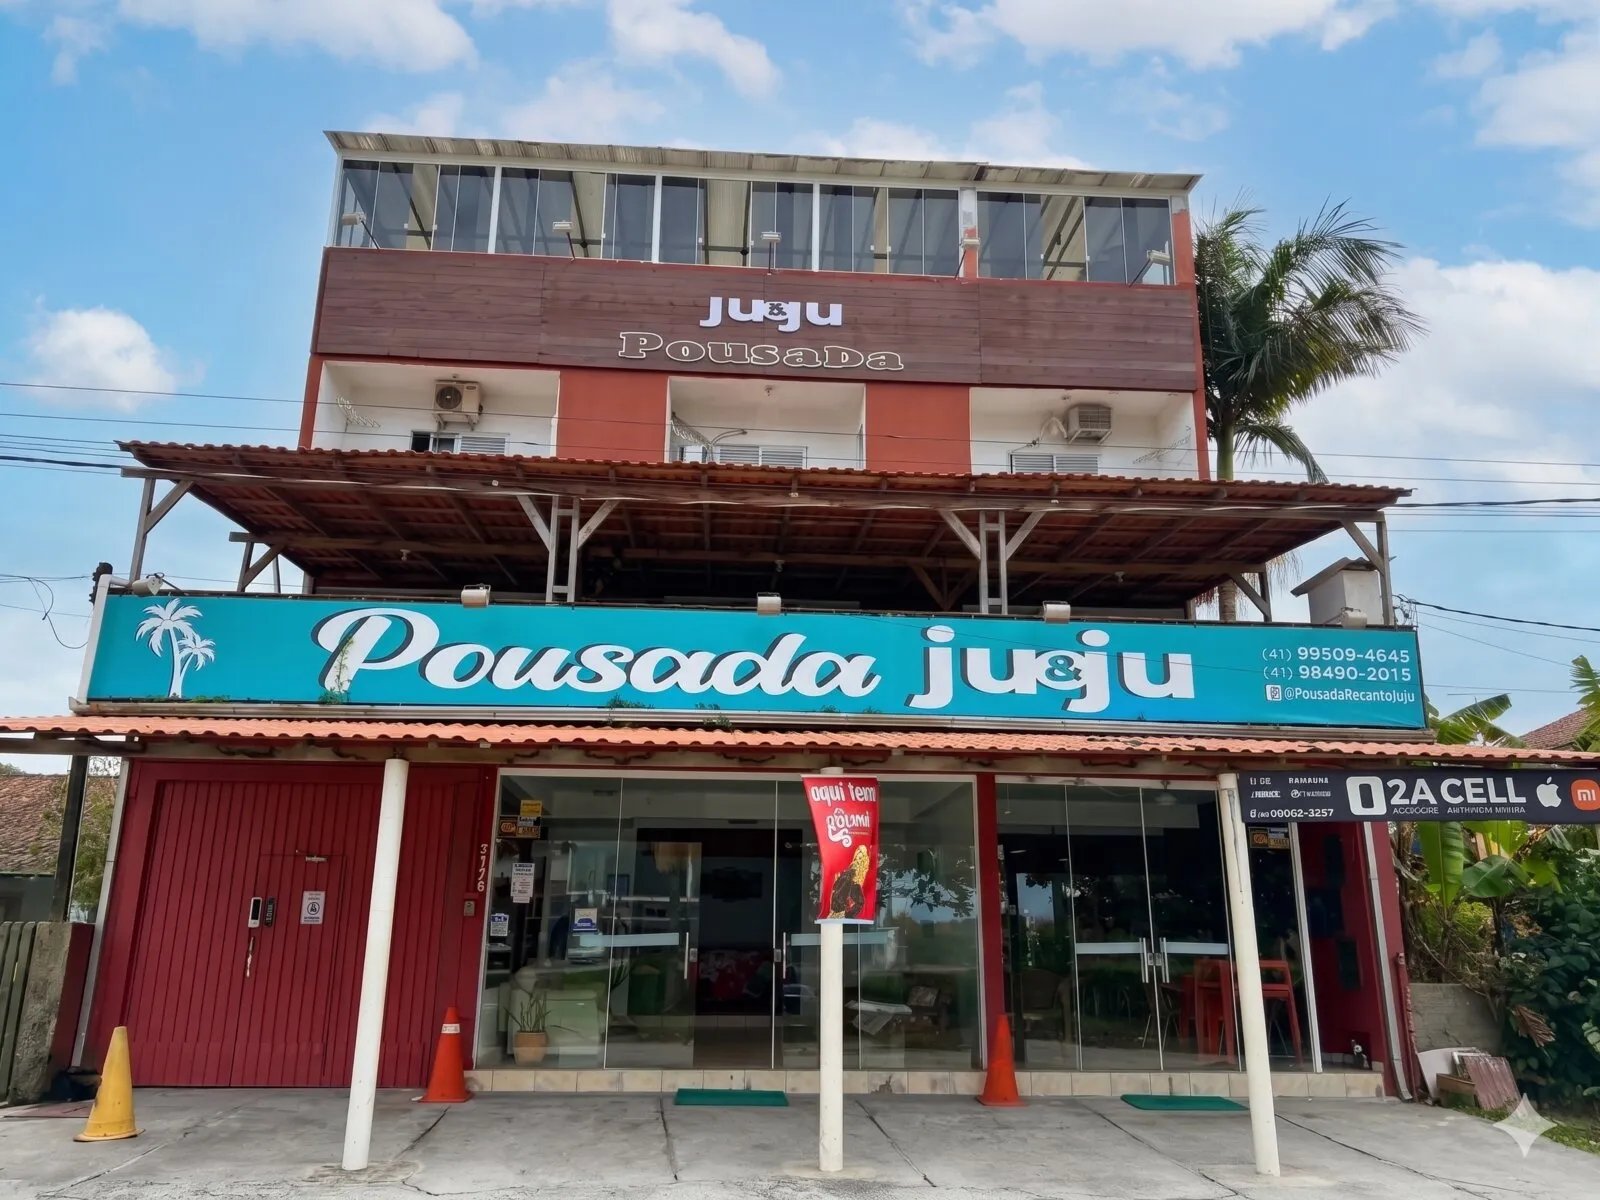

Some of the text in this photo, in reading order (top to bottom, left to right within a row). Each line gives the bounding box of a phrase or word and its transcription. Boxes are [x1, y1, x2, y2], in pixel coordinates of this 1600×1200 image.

[311, 606, 1196, 713] Pousada ju&ju
[1262, 646, 1411, 663] (41) 99509-4645
[1263, 665, 1412, 682] (41) 98490-2015
[810, 781, 877, 807] aqui tem
[1440, 777, 1527, 804] CELL
[477, 843, 489, 893] 3176
